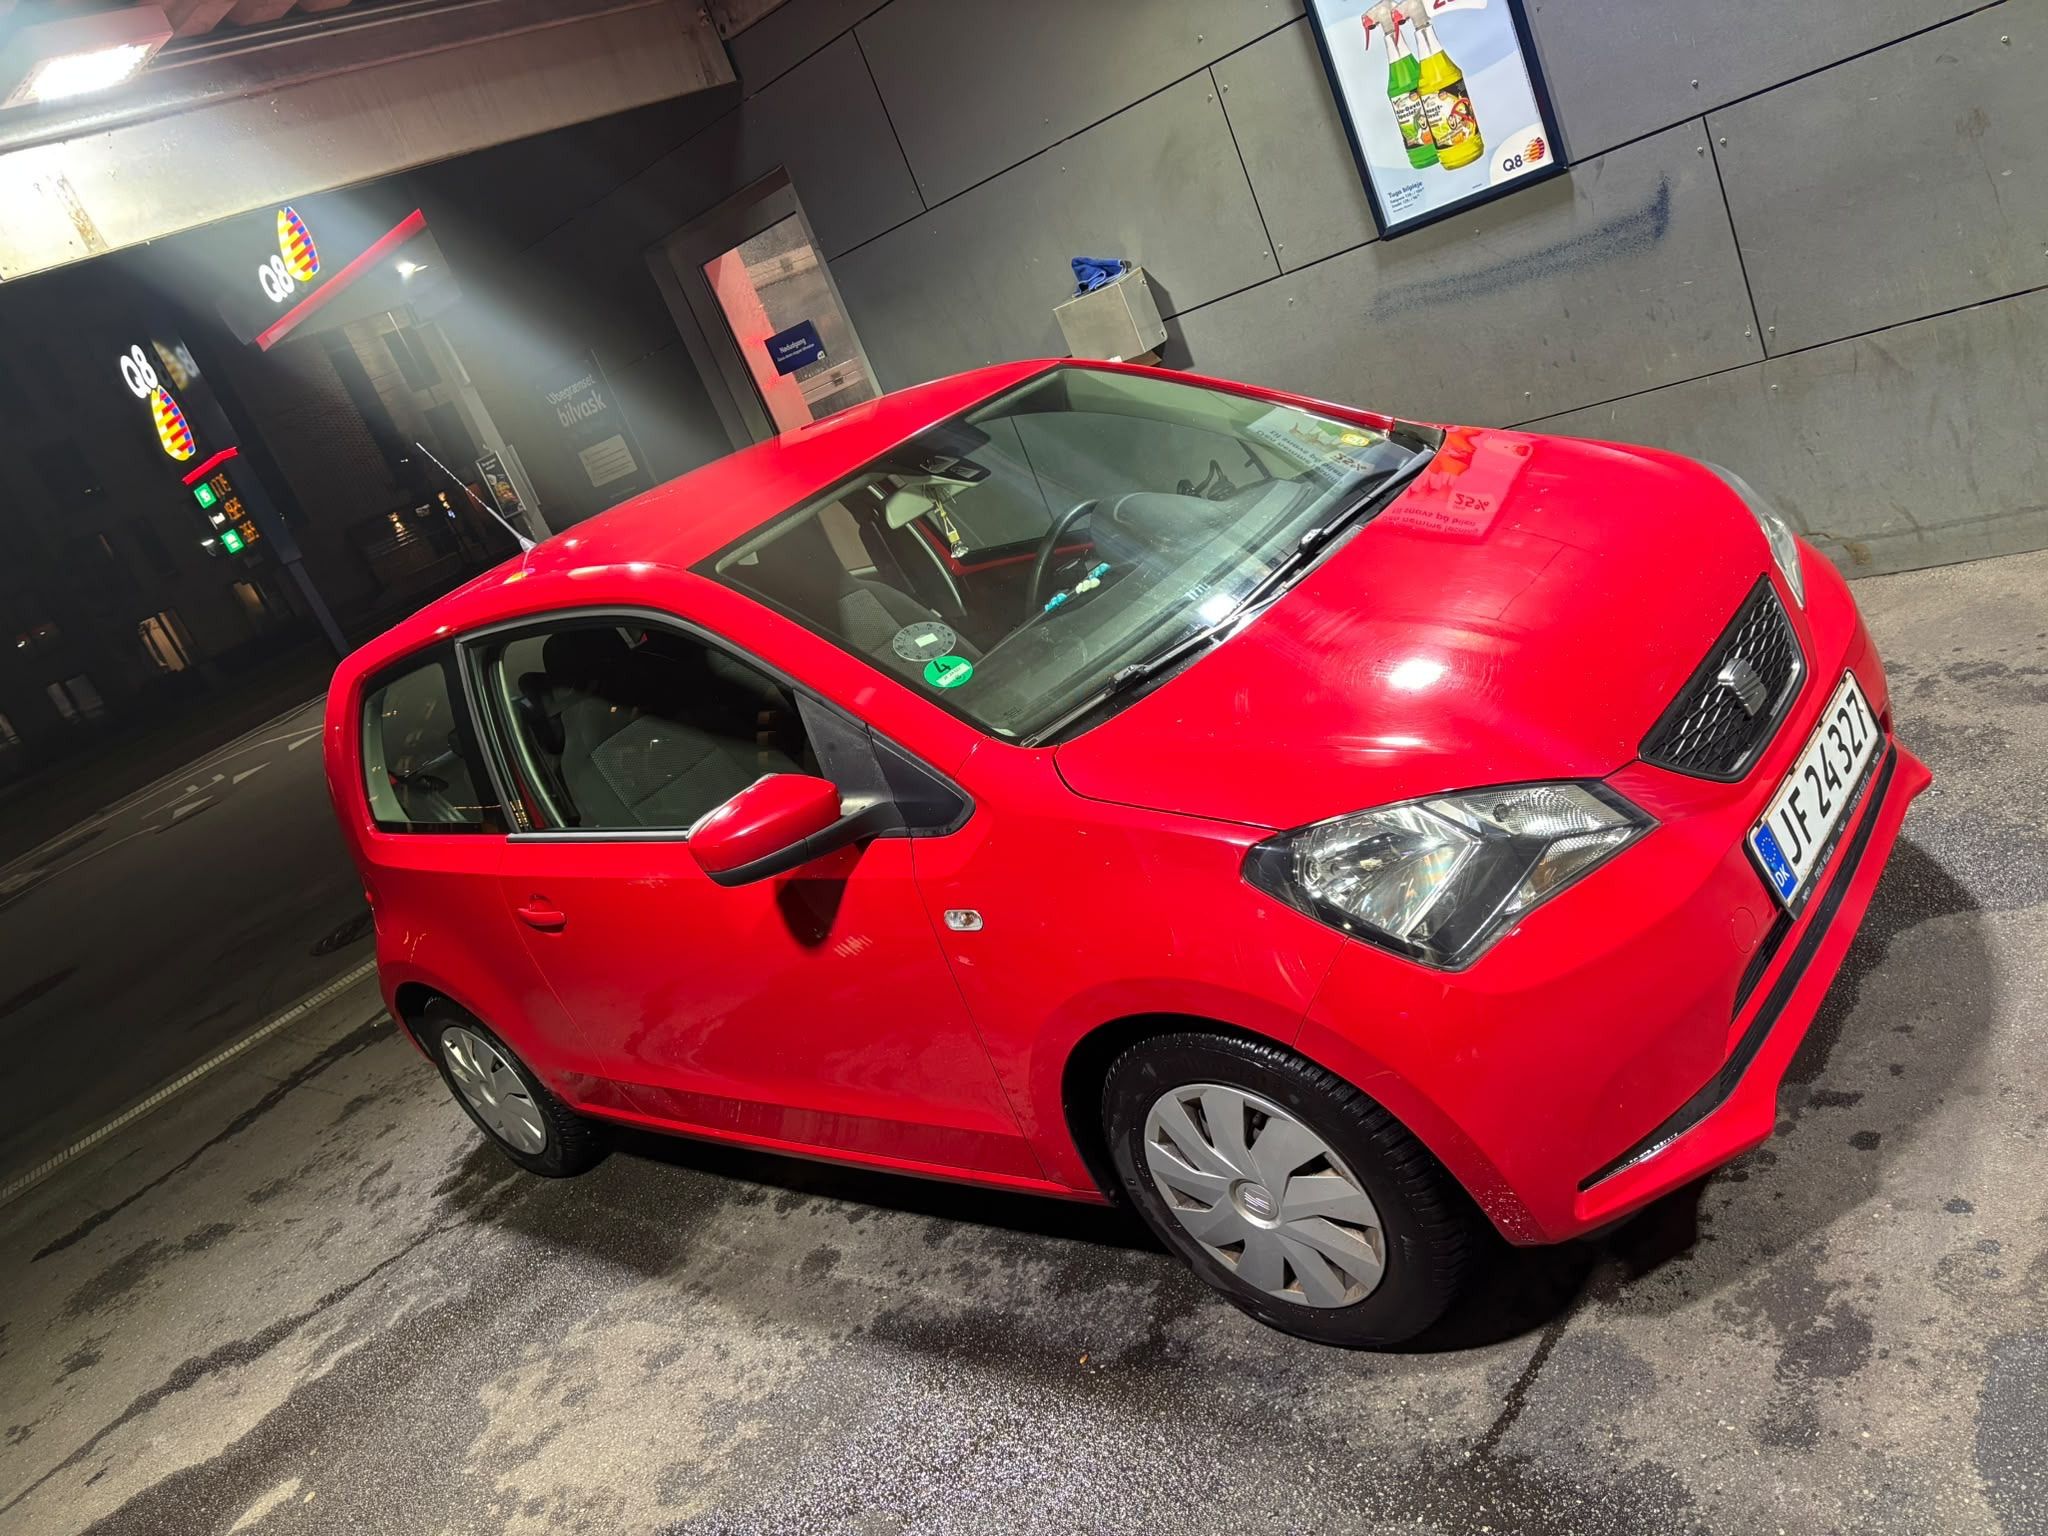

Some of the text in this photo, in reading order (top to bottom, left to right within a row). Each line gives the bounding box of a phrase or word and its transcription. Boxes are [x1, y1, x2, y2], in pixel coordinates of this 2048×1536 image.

[1502, 154, 1523, 173] Q8
[258, 254, 295, 302] Q8
[120, 344, 158, 398] Q8
[545, 373, 596, 404] Ubegrænset
[557, 389, 607, 428] bilvask
[933, 660, 951, 673] 4
[1779, 785, 1812, 866] JF
[1804, 743, 1843, 819] 24
[1827, 688, 1869, 775] 327
[1774, 866, 1791, 888] DK
